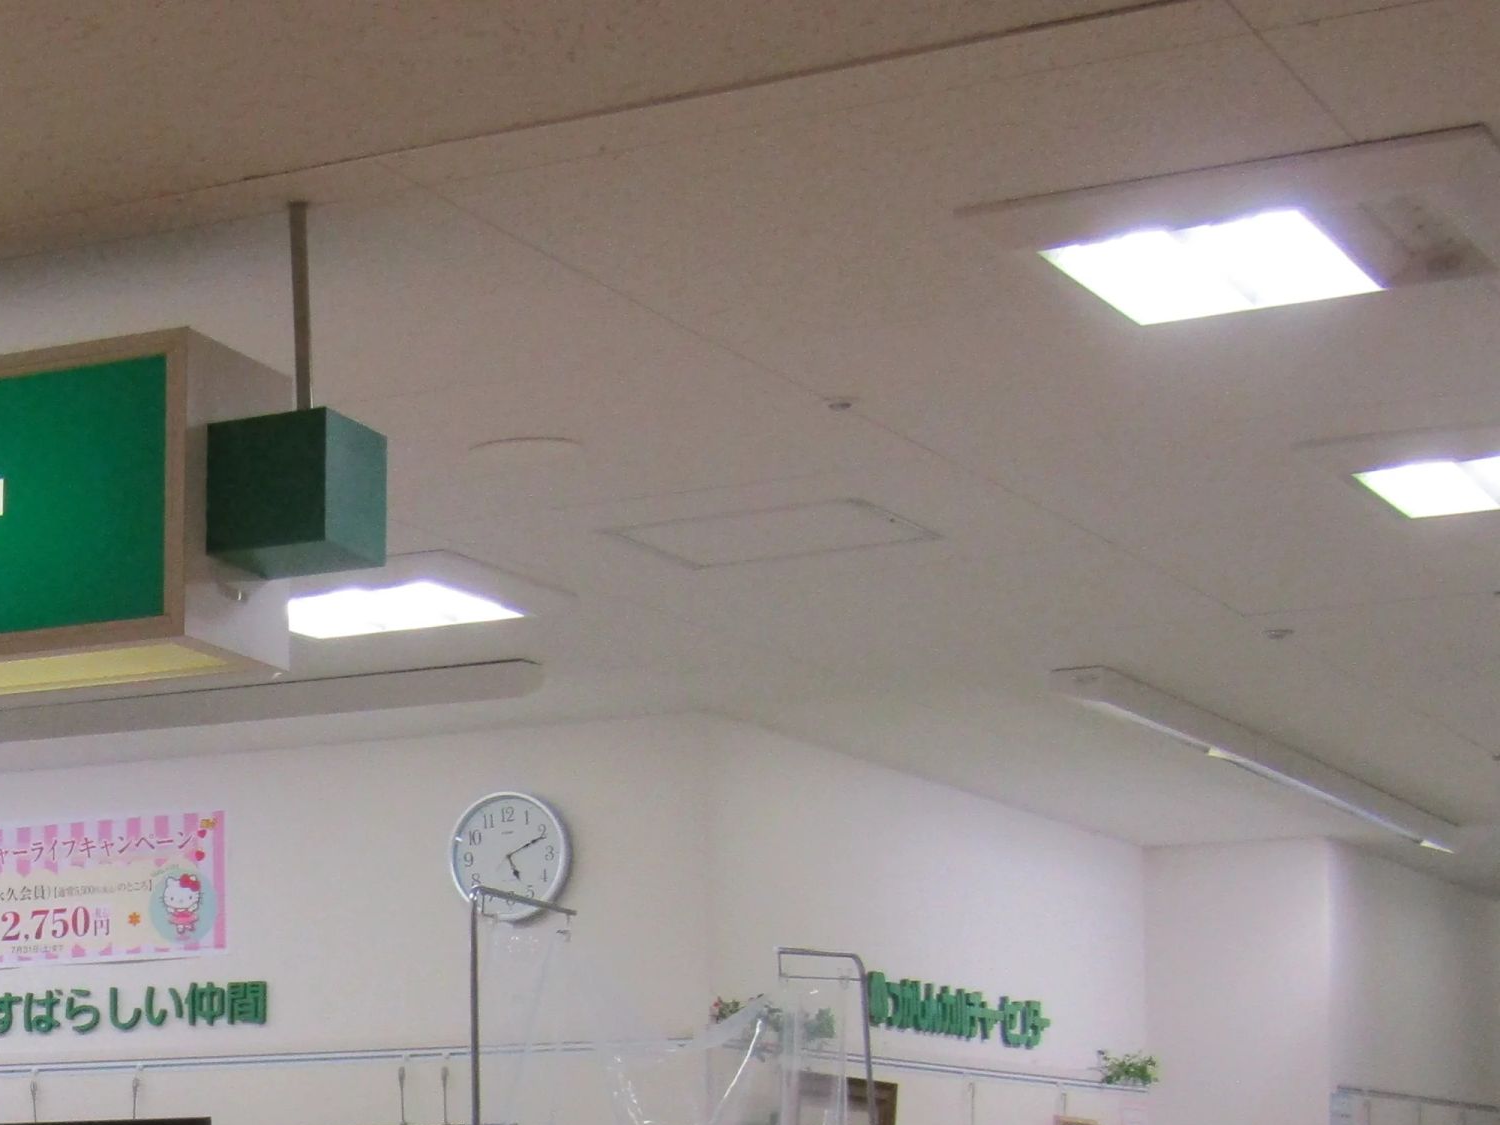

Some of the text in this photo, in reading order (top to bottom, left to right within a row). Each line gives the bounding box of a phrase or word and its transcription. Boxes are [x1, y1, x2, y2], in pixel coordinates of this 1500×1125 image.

[483, 814, 495, 829] 11
[501, 806, 515, 822] 12
[469, 830, 482, 846] 10
[464, 852, 474, 867] 9
[545, 845, 555, 861] 3
